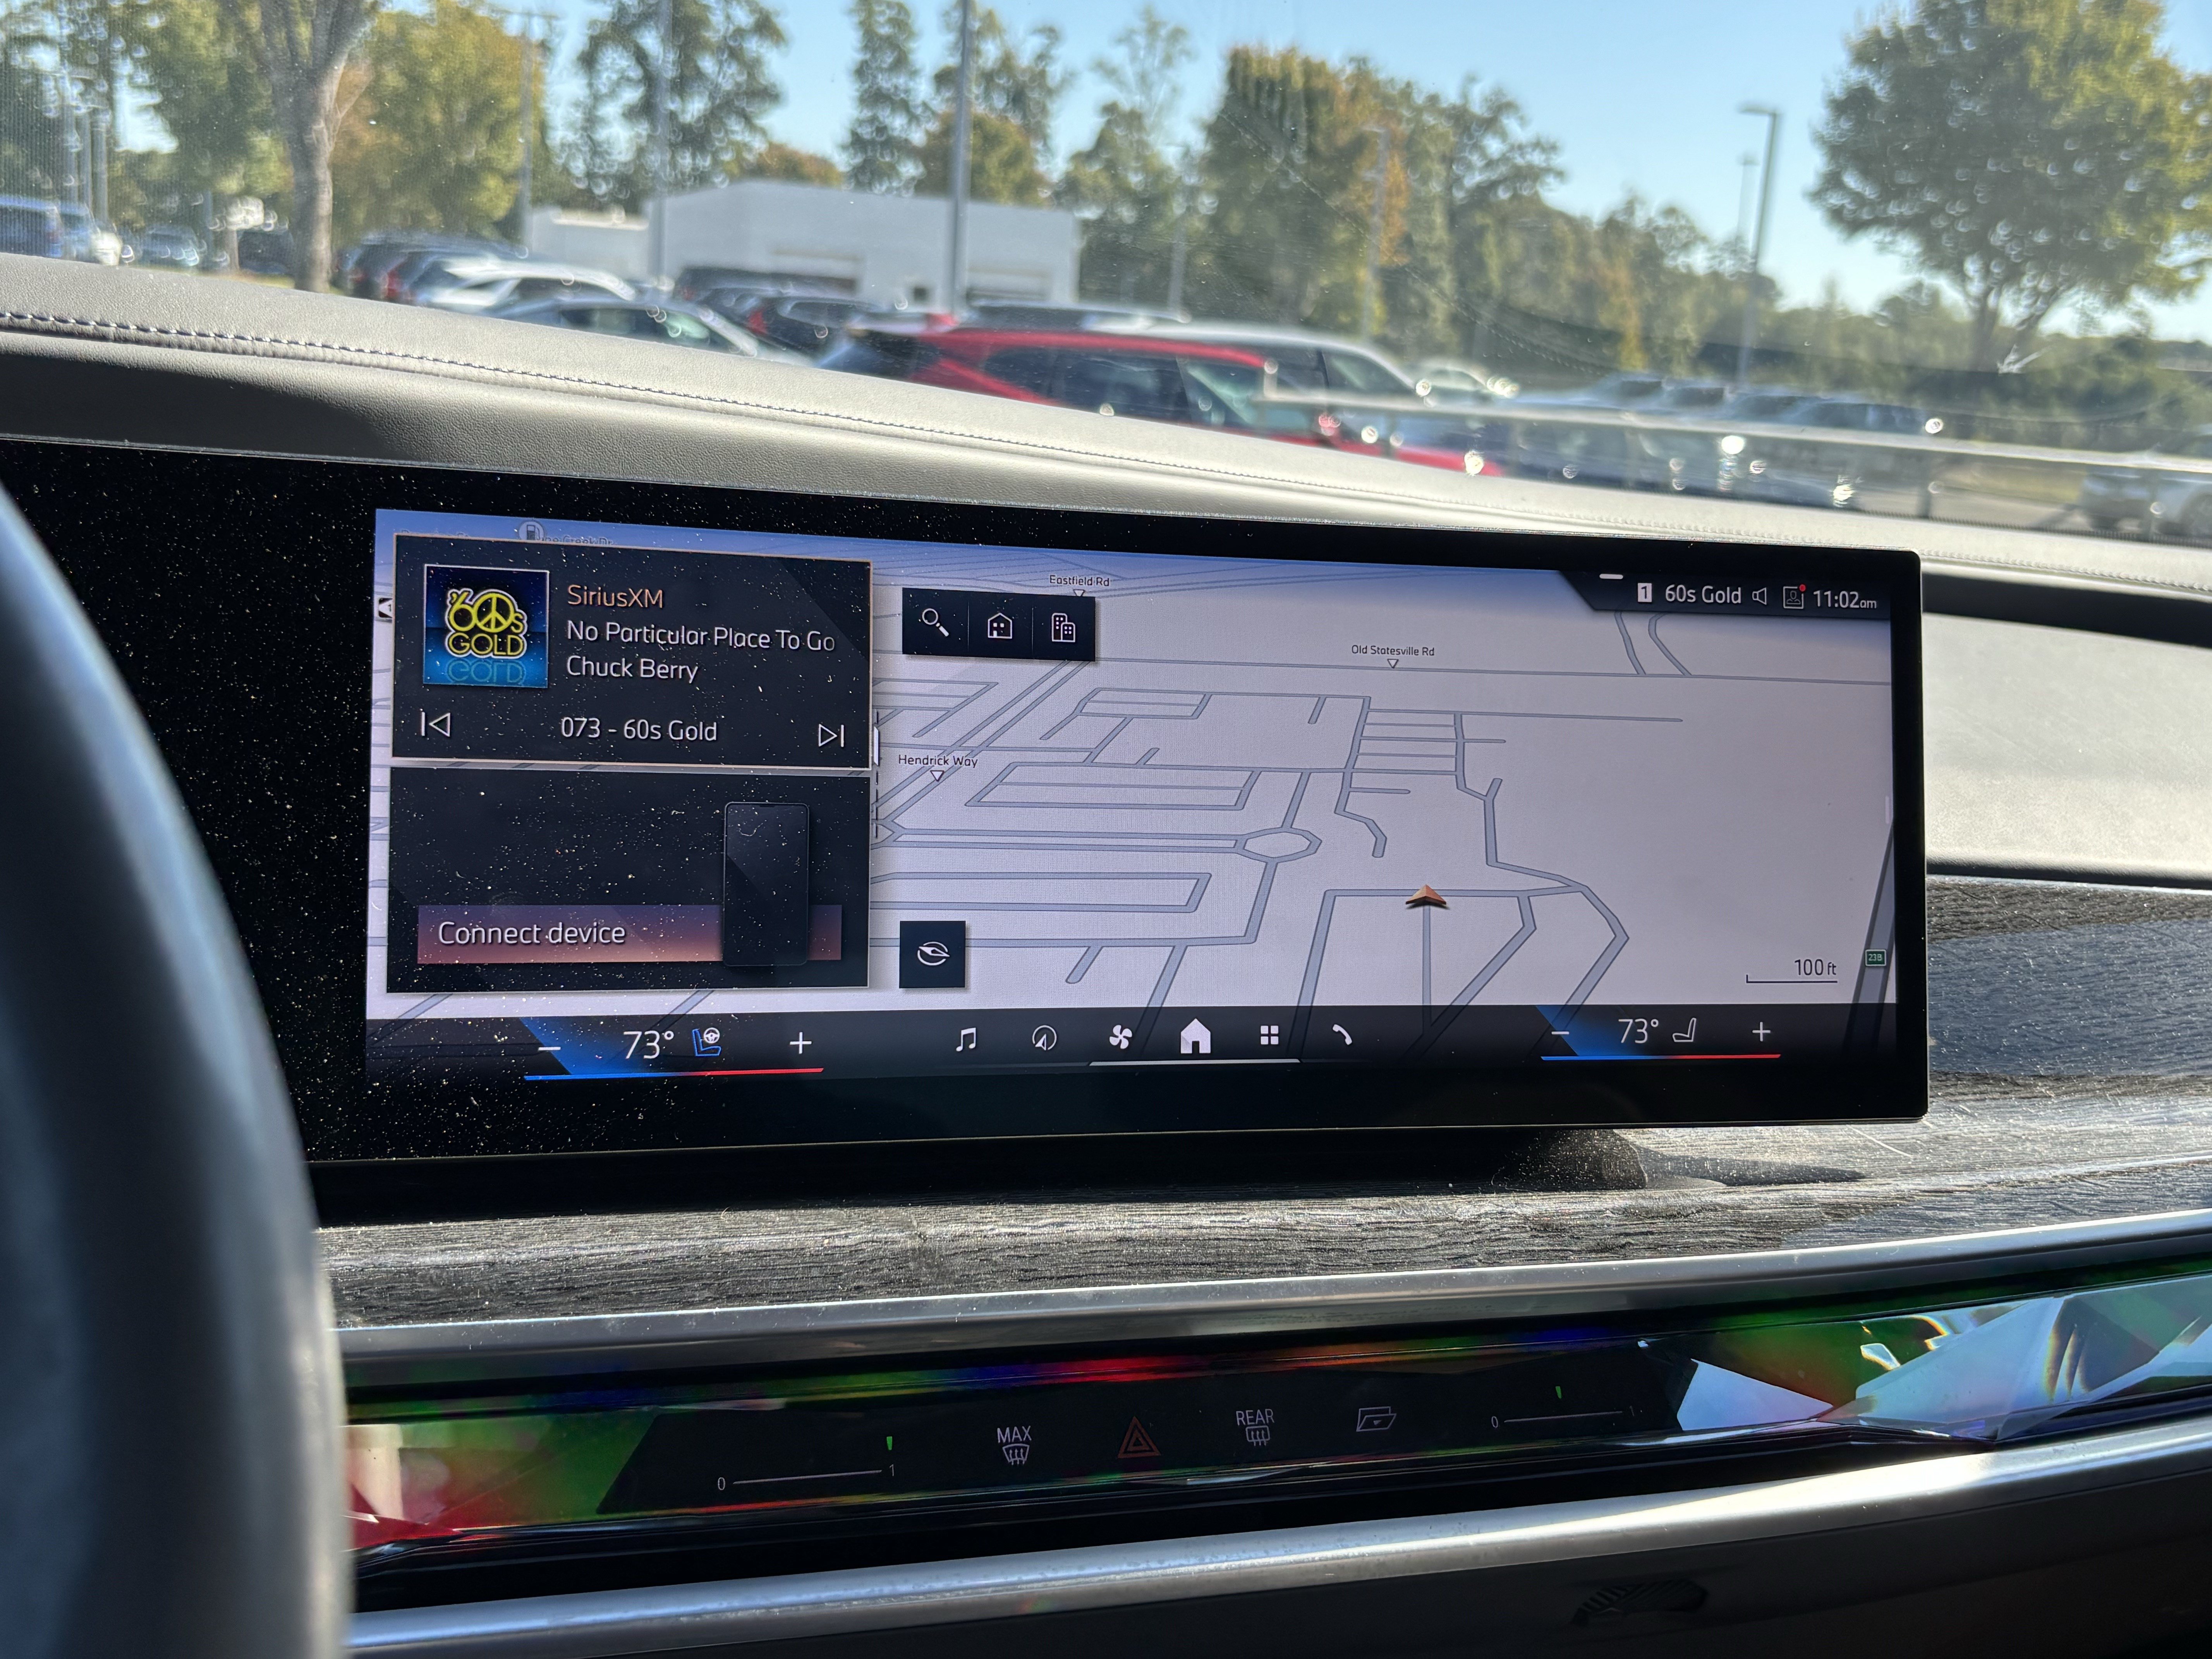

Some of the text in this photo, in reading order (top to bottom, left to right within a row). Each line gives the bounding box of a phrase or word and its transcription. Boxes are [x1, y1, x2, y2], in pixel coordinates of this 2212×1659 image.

[1049, 575, 1110, 587] Eastfield Rd
[568, 584, 663, 608] SiriusXM
[1665, 584, 1741, 604] 60s Gold
[448, 632, 524, 656] GOLD
[567, 620, 835, 651] No Particular Place To Go
[1351, 644, 1435, 656] Old Statesville Rd
[567, 654, 699, 684] Chuck Berry
[561, 716, 600, 739] 073
[623, 719, 661, 740] 60s
[668, 720, 717, 742] Gold
[898, 754, 978, 769] Hendrick Way
[438, 921, 626, 945] Connect device
[1793, 958, 1837, 976] 100 ft
[1868, 953, 1883, 962] 23B
[1618, 1018, 1659, 1044] 73°
[623, 1030, 675, 1060] 73°
[1236, 1408, 1275, 1427] REAR
[1491, 1415, 1499, 1429] 0
[997, 1425, 1032, 1444] MAX
[889, 1463, 895, 1477] 1
[717, 1476, 726, 1491] 0
